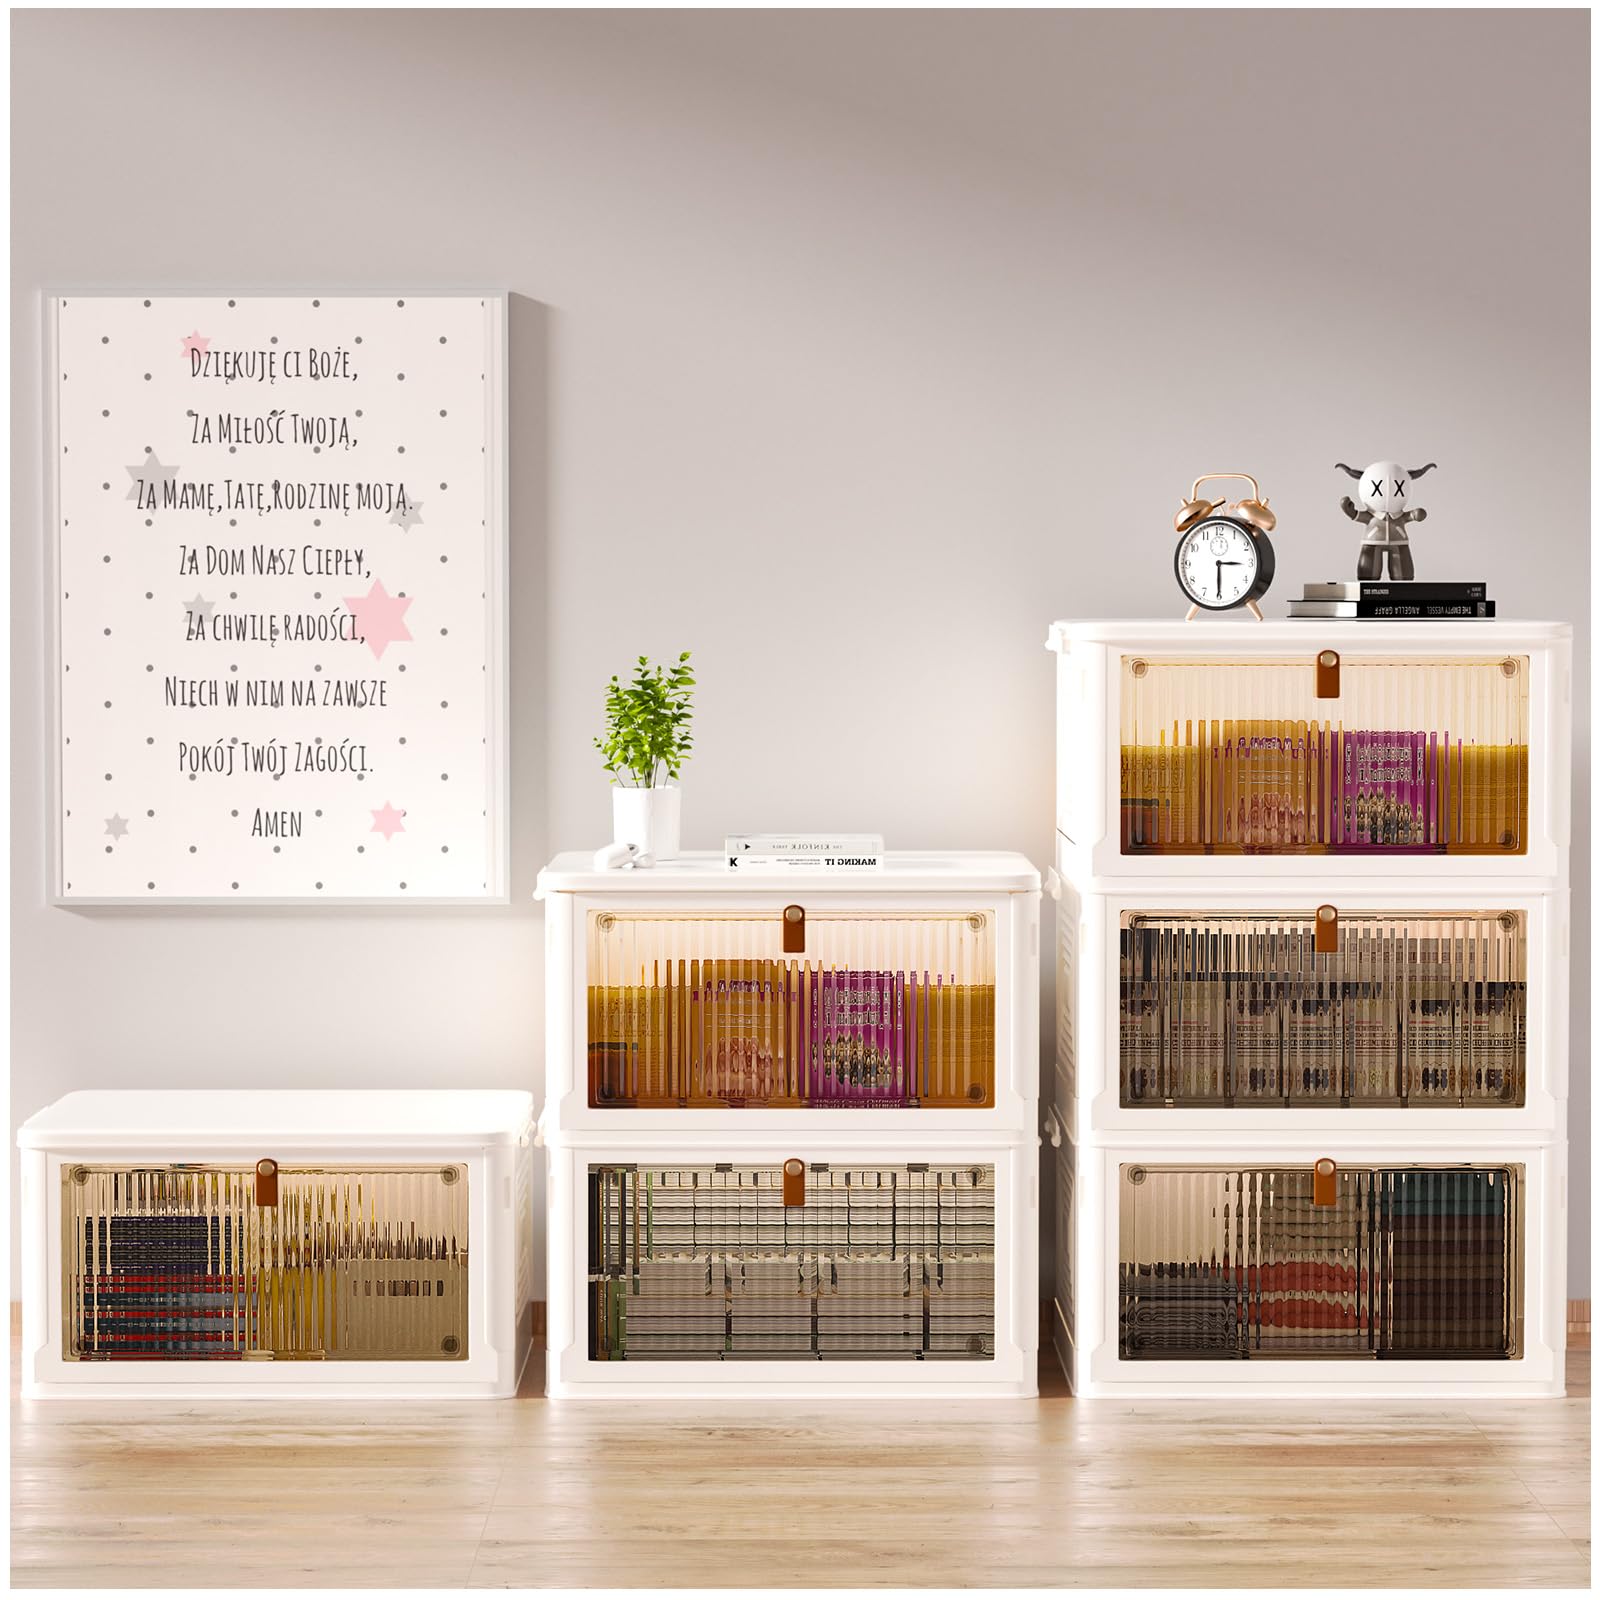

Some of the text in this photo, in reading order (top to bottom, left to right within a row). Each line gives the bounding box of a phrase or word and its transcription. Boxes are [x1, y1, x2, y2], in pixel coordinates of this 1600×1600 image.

[1202, 531, 1209, 541] 11
[1215, 526, 1224, 536] 12
[1190, 543, 1199, 553] 10
[1243, 541, 1249, 551] 2
[1184, 559, 1191, 569] 9
[1248, 558, 1254, 568] 3
[1189, 576, 1196, 585] 8
[1243, 575, 1248, 584] 4
[1201, 587, 1207, 597] 7
[1233, 586, 1239, 596] 5
